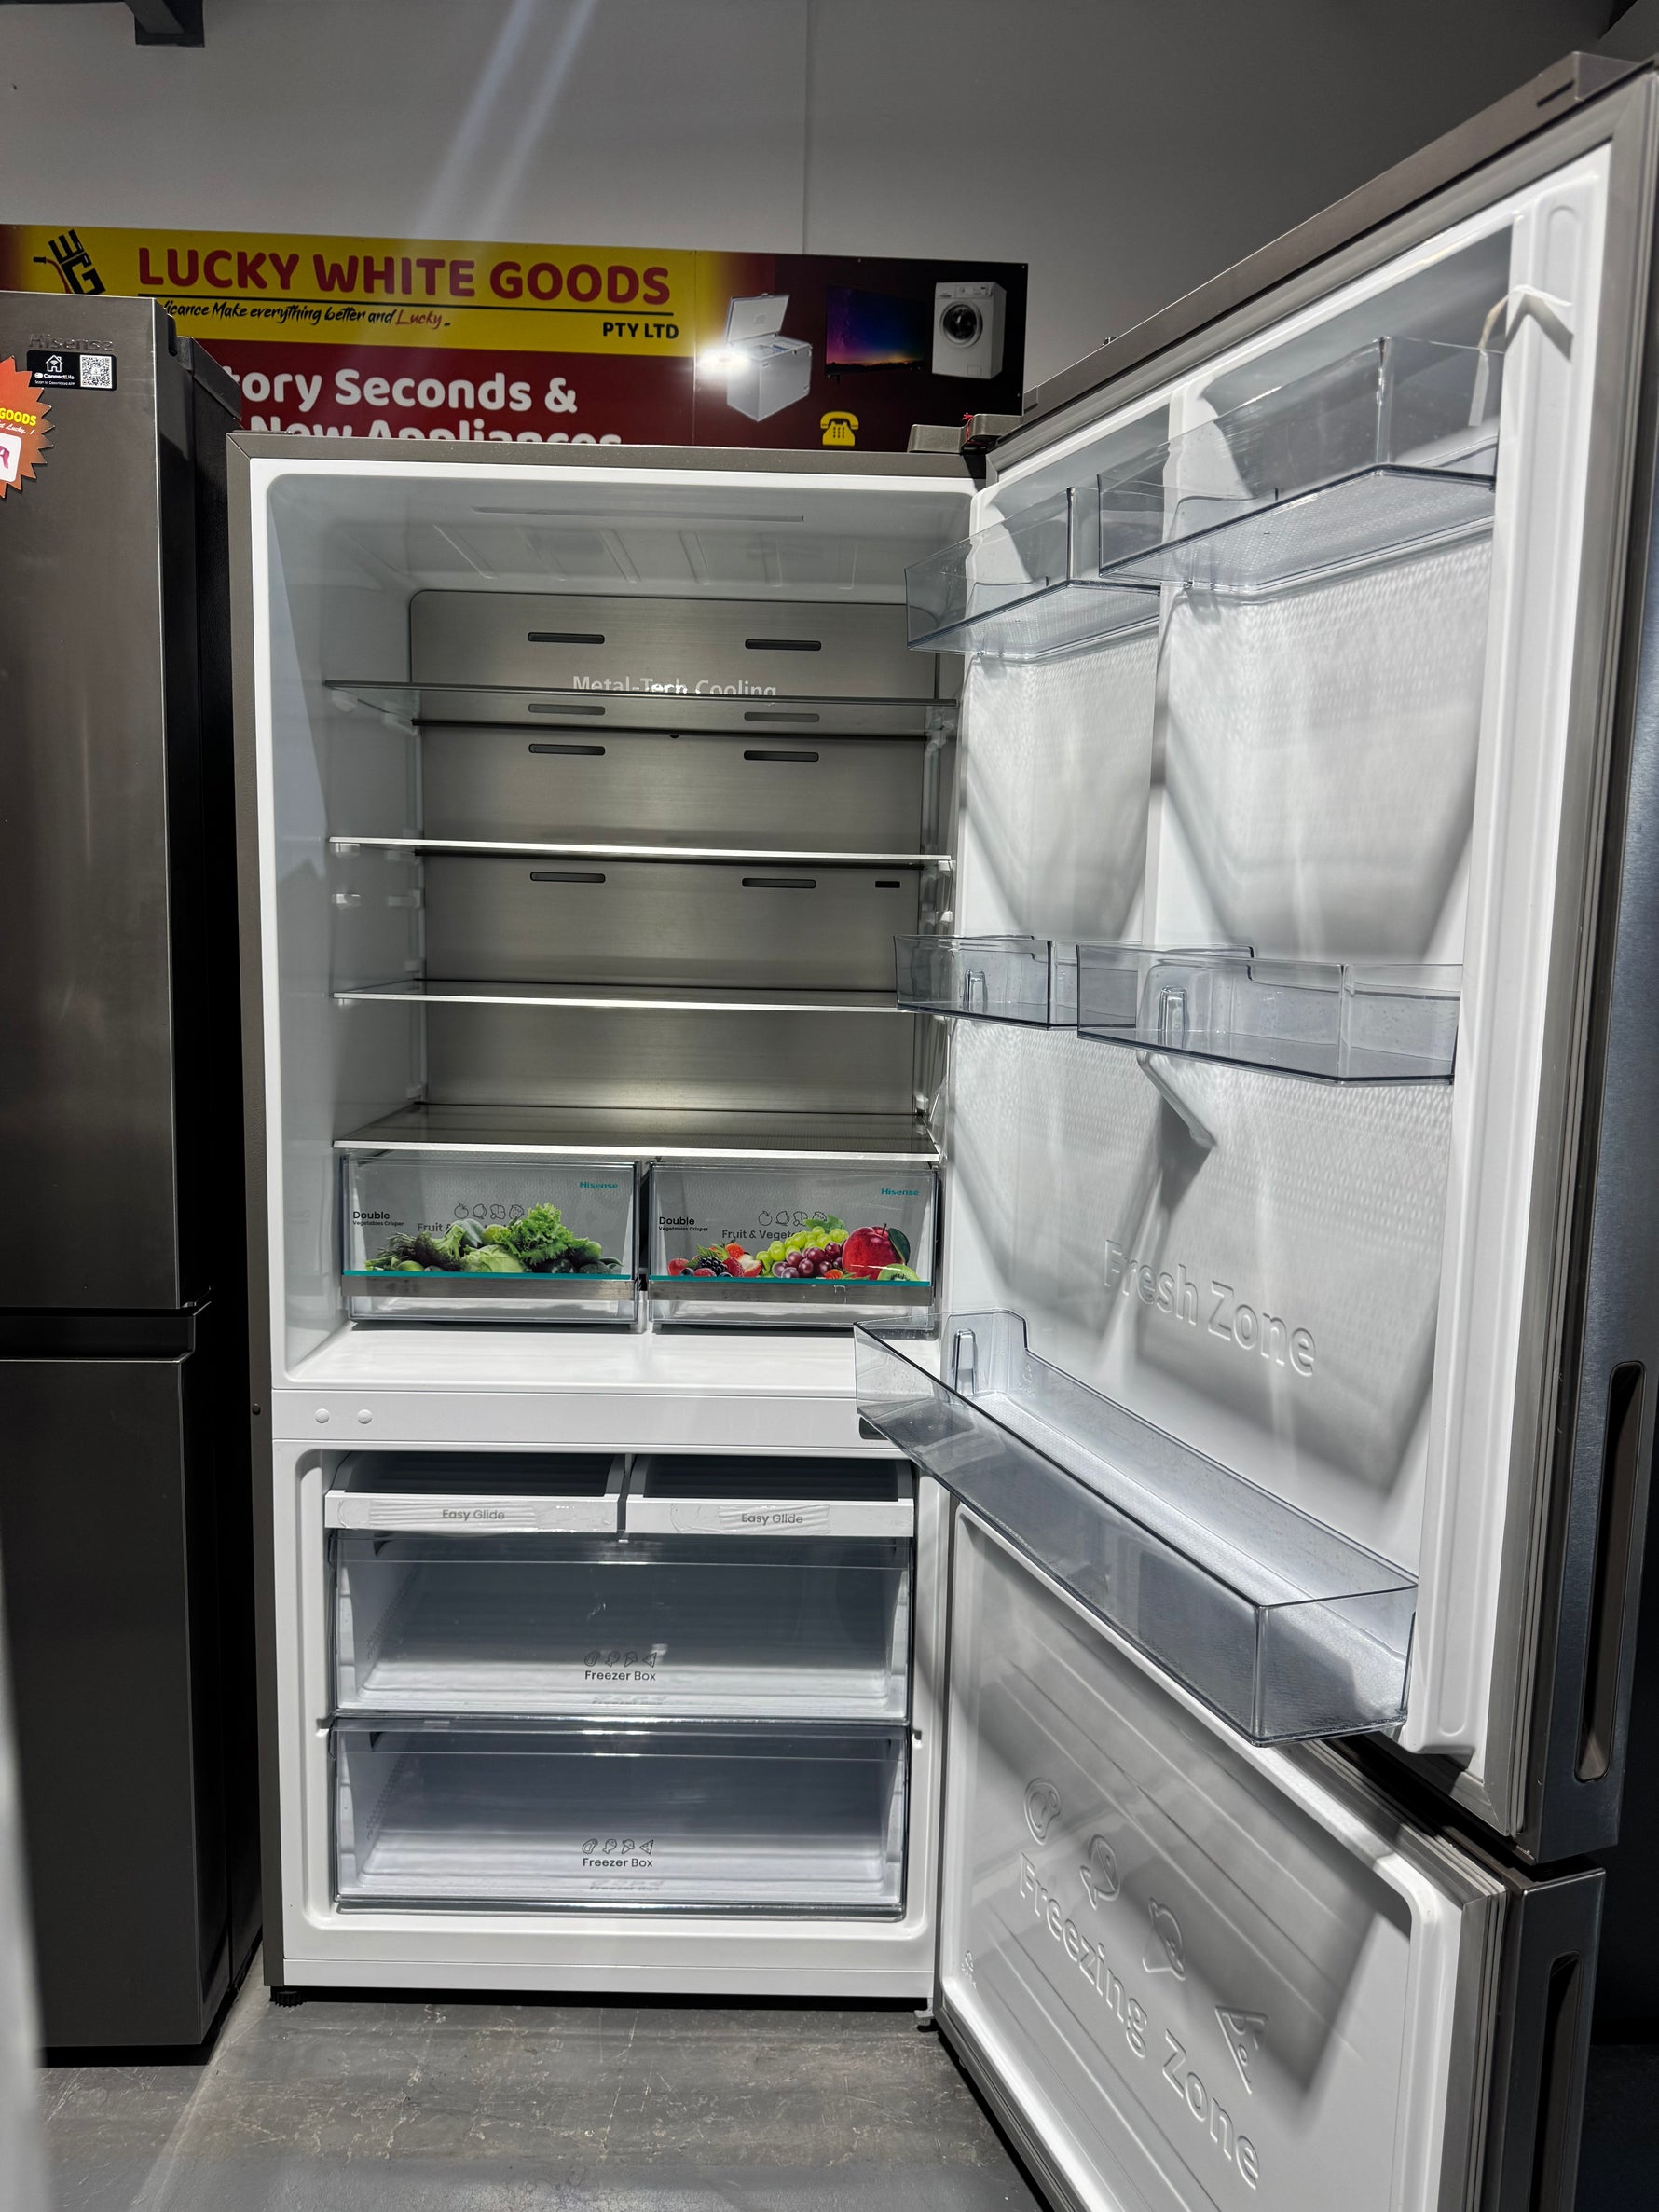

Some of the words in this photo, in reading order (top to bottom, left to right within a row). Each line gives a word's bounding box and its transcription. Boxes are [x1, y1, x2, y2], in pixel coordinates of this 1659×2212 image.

[138, 246, 300, 290] LUCKY
[312, 252, 476, 297] WHITE
[489, 261, 671, 306] GOODS
[211, 301, 248, 321] Make
[250, 304, 322, 326] everything
[324, 306, 366, 323] better
[367, 309, 397, 323] and
[602, 322, 639, 337] PTY
[644, 323, 679, 339] LTD
[29, 333, 114, 351] Hisense
[335, 368, 533, 412] Seconds
[544, 377, 578, 413] &
[0, 407, 37, 427] GOODS
[694, 680, 777, 696] Cooling
[579, 1181, 619, 1189] Hisense
[880, 1188, 919, 1196] Hisense
[352, 1211, 391, 1219] Double
[659, 1216, 695, 1226] Double
[417, 1222, 443, 1232] Fruit
[721, 1229, 747, 1239] Fruit
[748, 1230, 757, 1239] &
[1104, 1238, 1199, 1326] Fresh
[1208, 1280, 1316, 1377] Zone
[442, 1509, 471, 1521] Easy
[473, 1509, 505, 1520] Glide
[741, 1513, 770, 1526] Easy
[772, 1513, 803, 1524] Glide
[584, 1669, 631, 1681] Freezer
[634, 1670, 656, 1681] Box
[583, 1857, 629, 1867] Freezer
[631, 1858, 653, 1868] Box
[1020, 1852, 1148, 2059] Freezing
[1162, 2028, 1261, 2191] Zone
